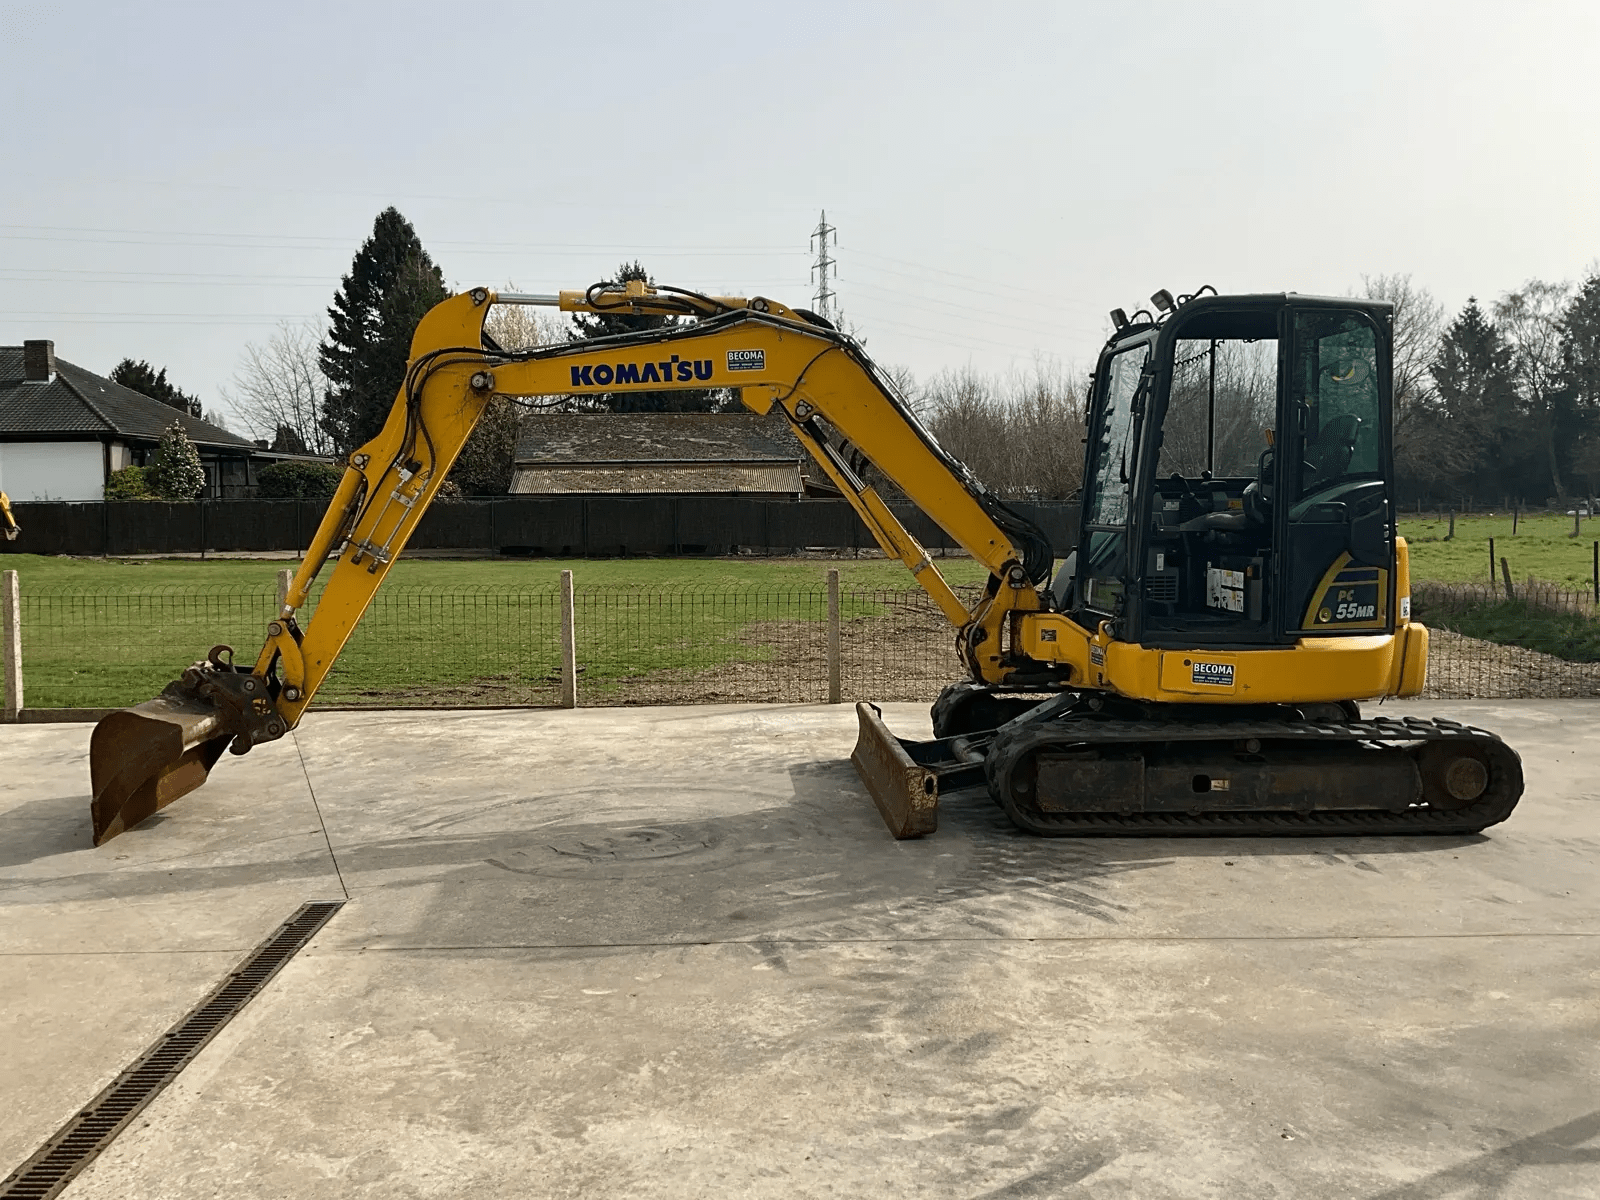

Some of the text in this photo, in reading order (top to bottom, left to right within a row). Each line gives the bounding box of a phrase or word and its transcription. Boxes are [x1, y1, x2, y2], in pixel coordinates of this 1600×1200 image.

[728, 351, 763, 361] BECOMA
[570, 355, 713, 386] KOMATSU
[1338, 590, 1354, 601] PC
[1336, 603, 1375, 619] 55MR
[1193, 663, 1233, 675] BECOMA
